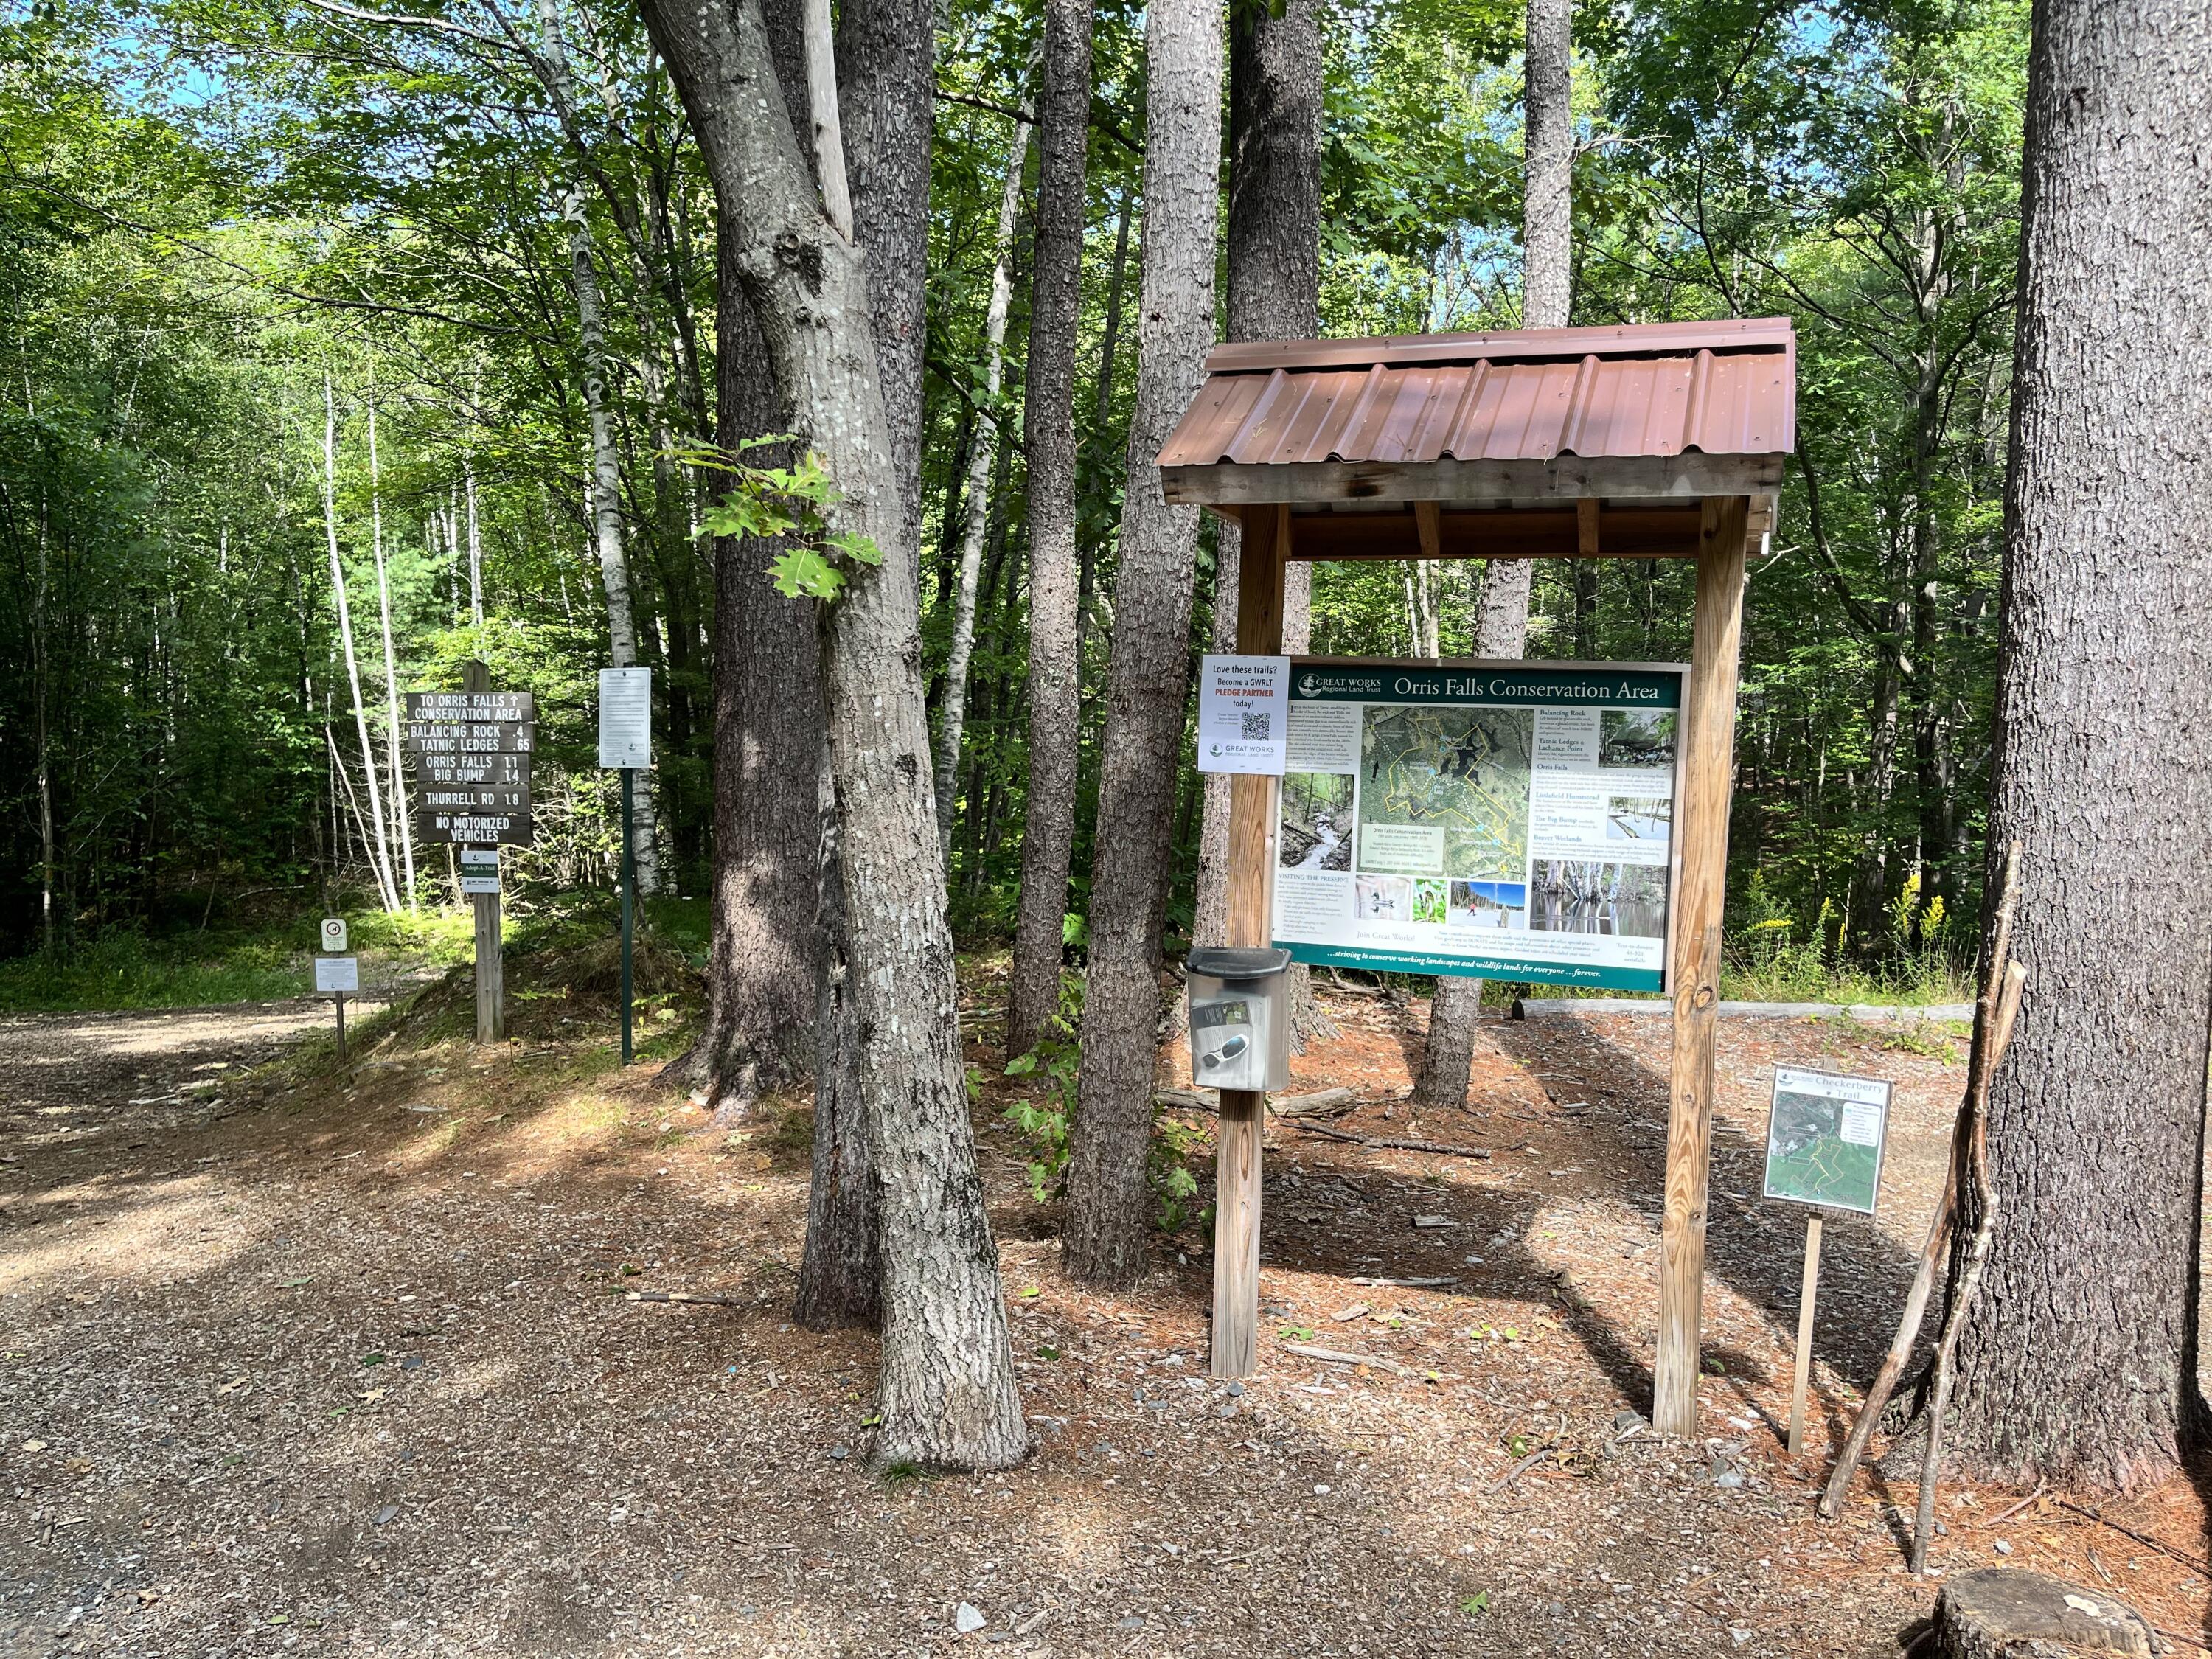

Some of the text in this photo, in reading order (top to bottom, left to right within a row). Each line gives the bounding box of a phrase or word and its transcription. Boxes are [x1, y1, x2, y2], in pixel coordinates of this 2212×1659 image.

[1213, 665, 1277, 675] Love these trails?
[1217, 678, 1243, 686] Become
[1250, 678, 1273, 686] GWRLT
[1348, 678, 1381, 686] WORKS
[1242, 689, 1274, 698] PARTNER
[1394, 678, 1660, 699] Orris Falls Conservation Area
[420, 695, 505, 707] TO ORRIS FALLS
[1233, 700, 1253, 709] today!
[414, 708, 522, 720] CONSERVATION AREA
[1540, 709, 1569, 717] Balancing
[411, 725, 467, 737] BALANCING
[473, 725, 501, 737] ROCK
[420, 739, 530, 751] TATNIC LEDGES .65
[426, 756, 456, 768] ORRIS
[461, 756, 493, 768] FALLS
[434, 769, 451, 781] BIG
[457, 769, 485, 781] BUMP
[425, 793, 477, 805] THURRELL
[481, 793, 495, 805] RD
[436, 816, 509, 830] NO MOTORIZED
[1559, 816, 1577, 824] Bump
[451, 830, 499, 842] VEHICLES
[1356, 931, 1370, 939] Join
[1397, 956, 1425, 966] working
[1426, 957, 1460, 968] landscapes
[1476, 960, 1502, 971] wildlife
[1503, 962, 1521, 972] lands
[1520, 964, 1533, 973] for
[1534, 967, 1565, 976] everyone
[1815, 1077, 1884, 1093] Checkerberry
[1836, 1089, 1860, 1100] Trail
